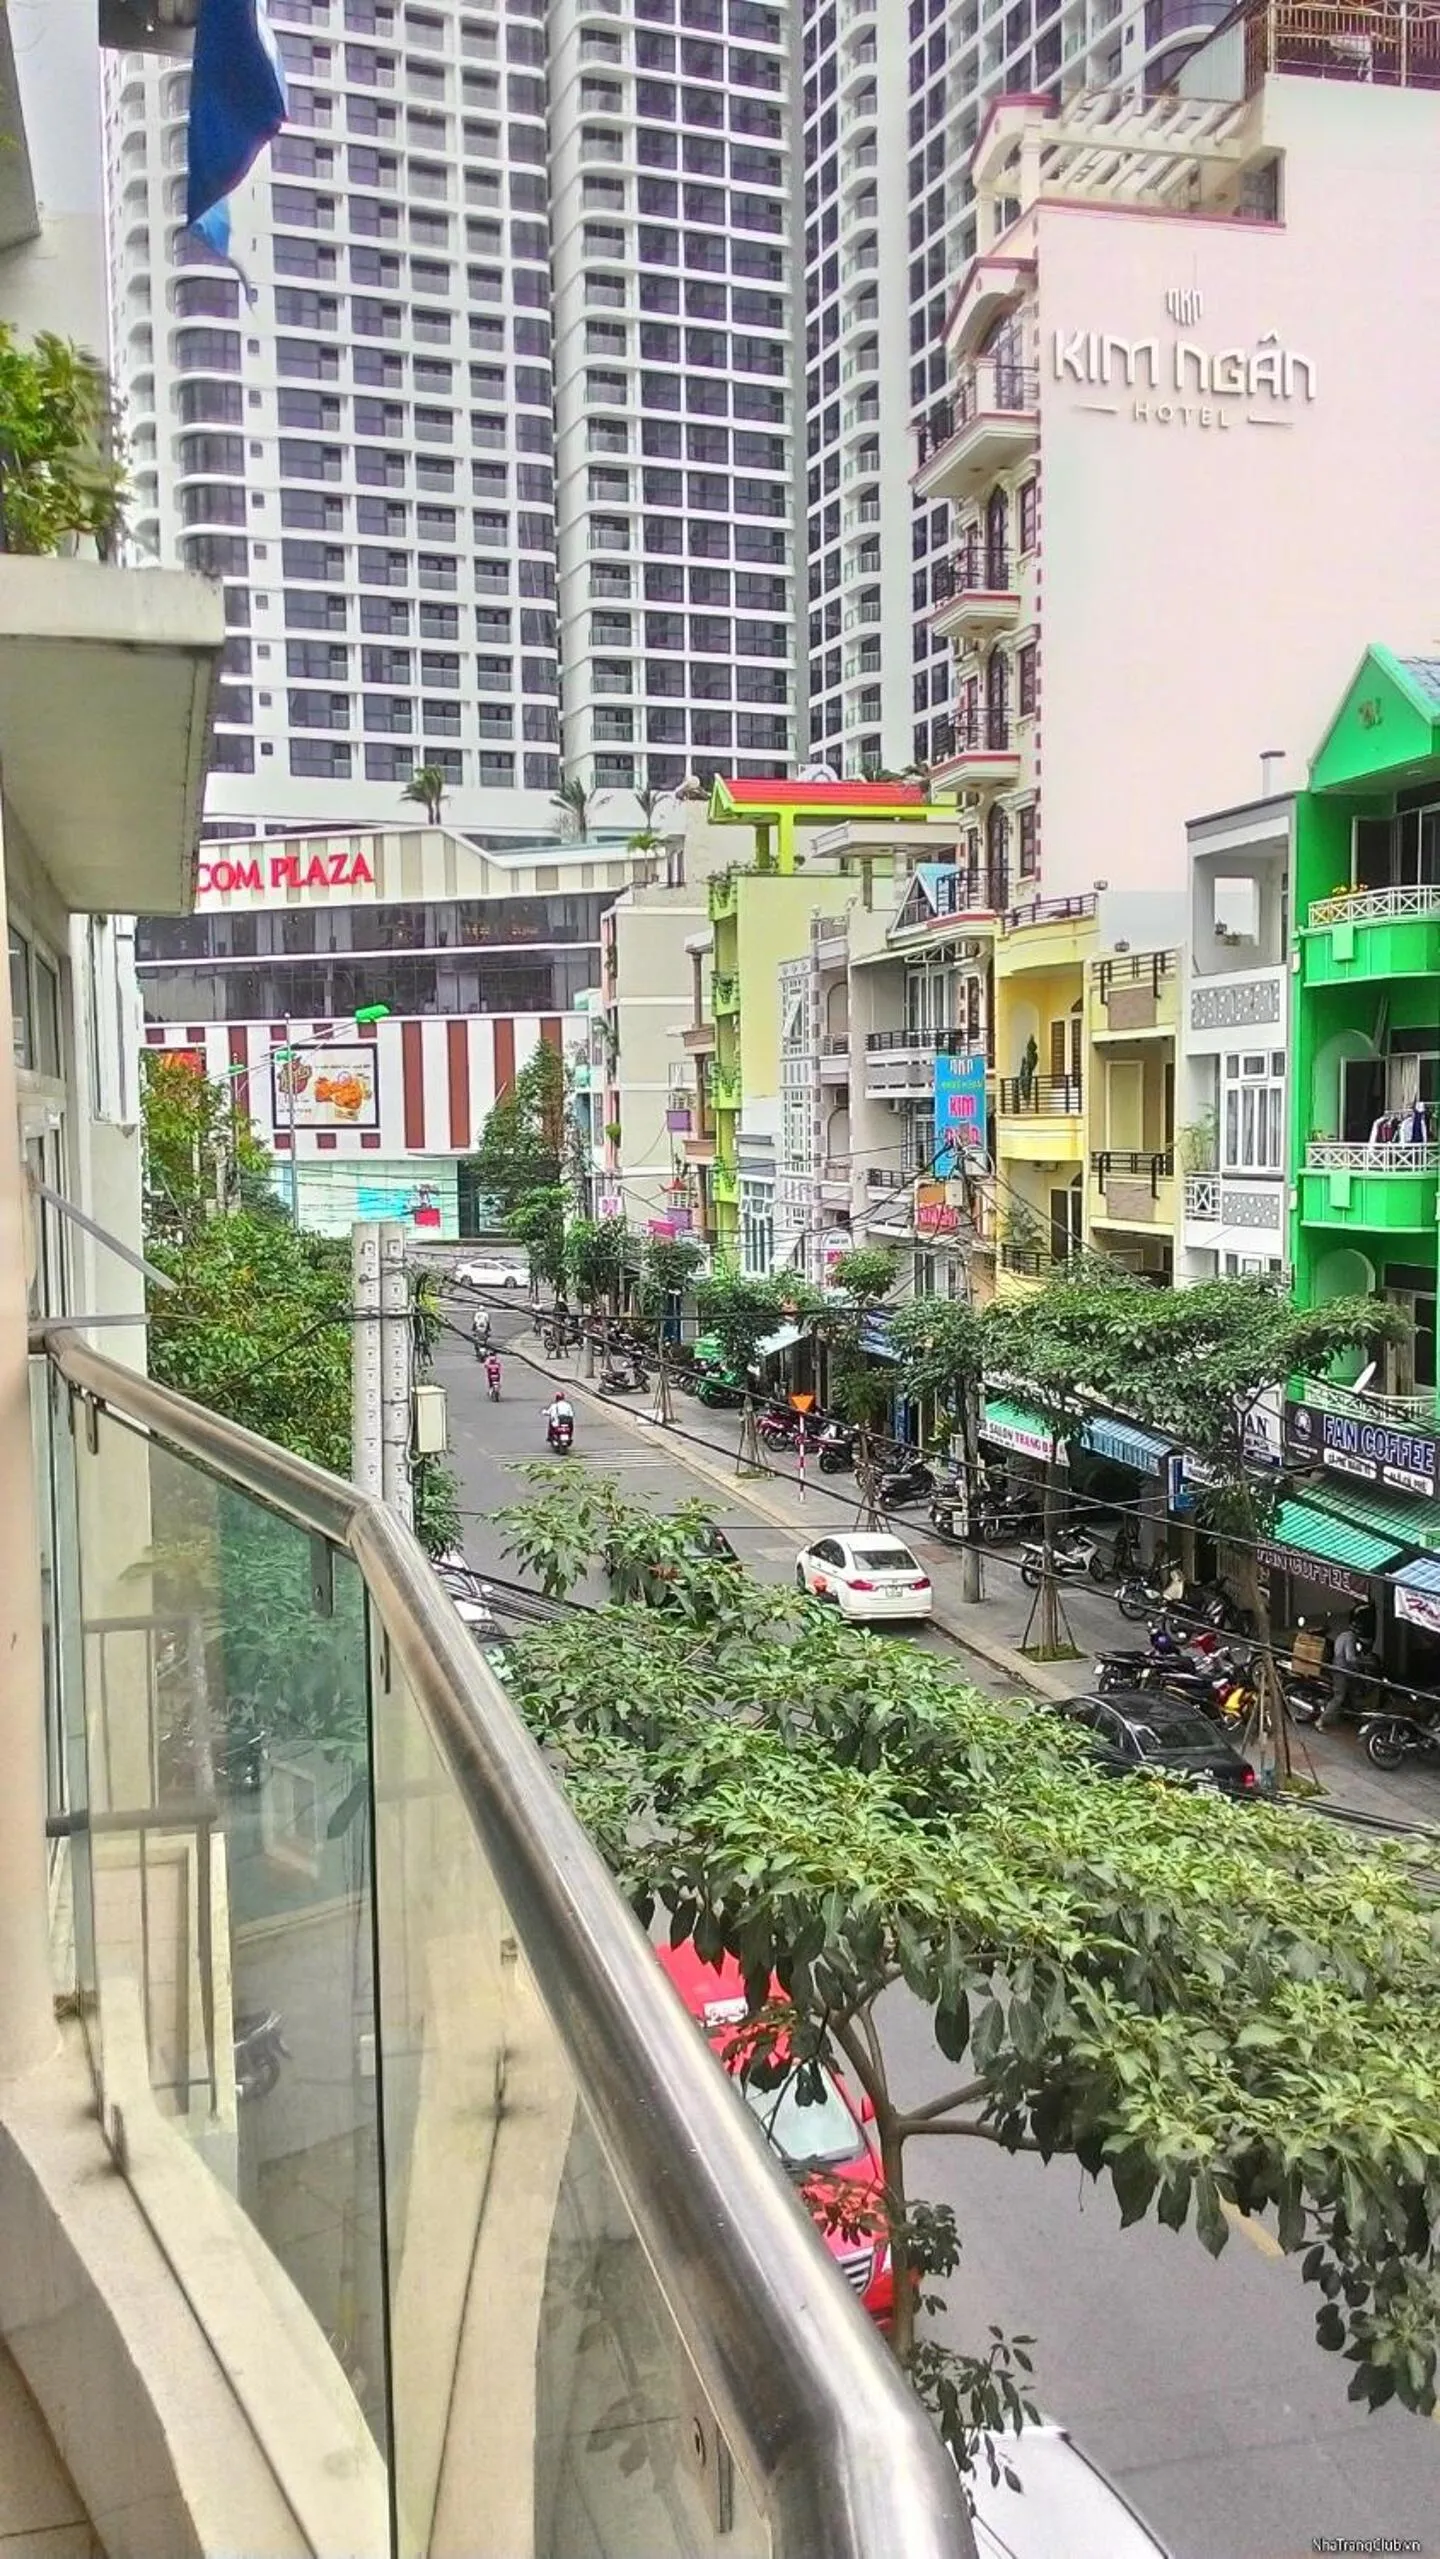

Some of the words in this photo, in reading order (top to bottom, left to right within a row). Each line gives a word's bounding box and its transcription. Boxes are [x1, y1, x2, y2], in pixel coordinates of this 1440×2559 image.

[1053, 327, 1160, 388] KIM
[1134, 399, 1231, 430] HOTEL
[270, 851, 375, 888] PLAZA
[1323, 1413, 1358, 1453] FAN
[1361, 1425, 1436, 1476] COFFEE
